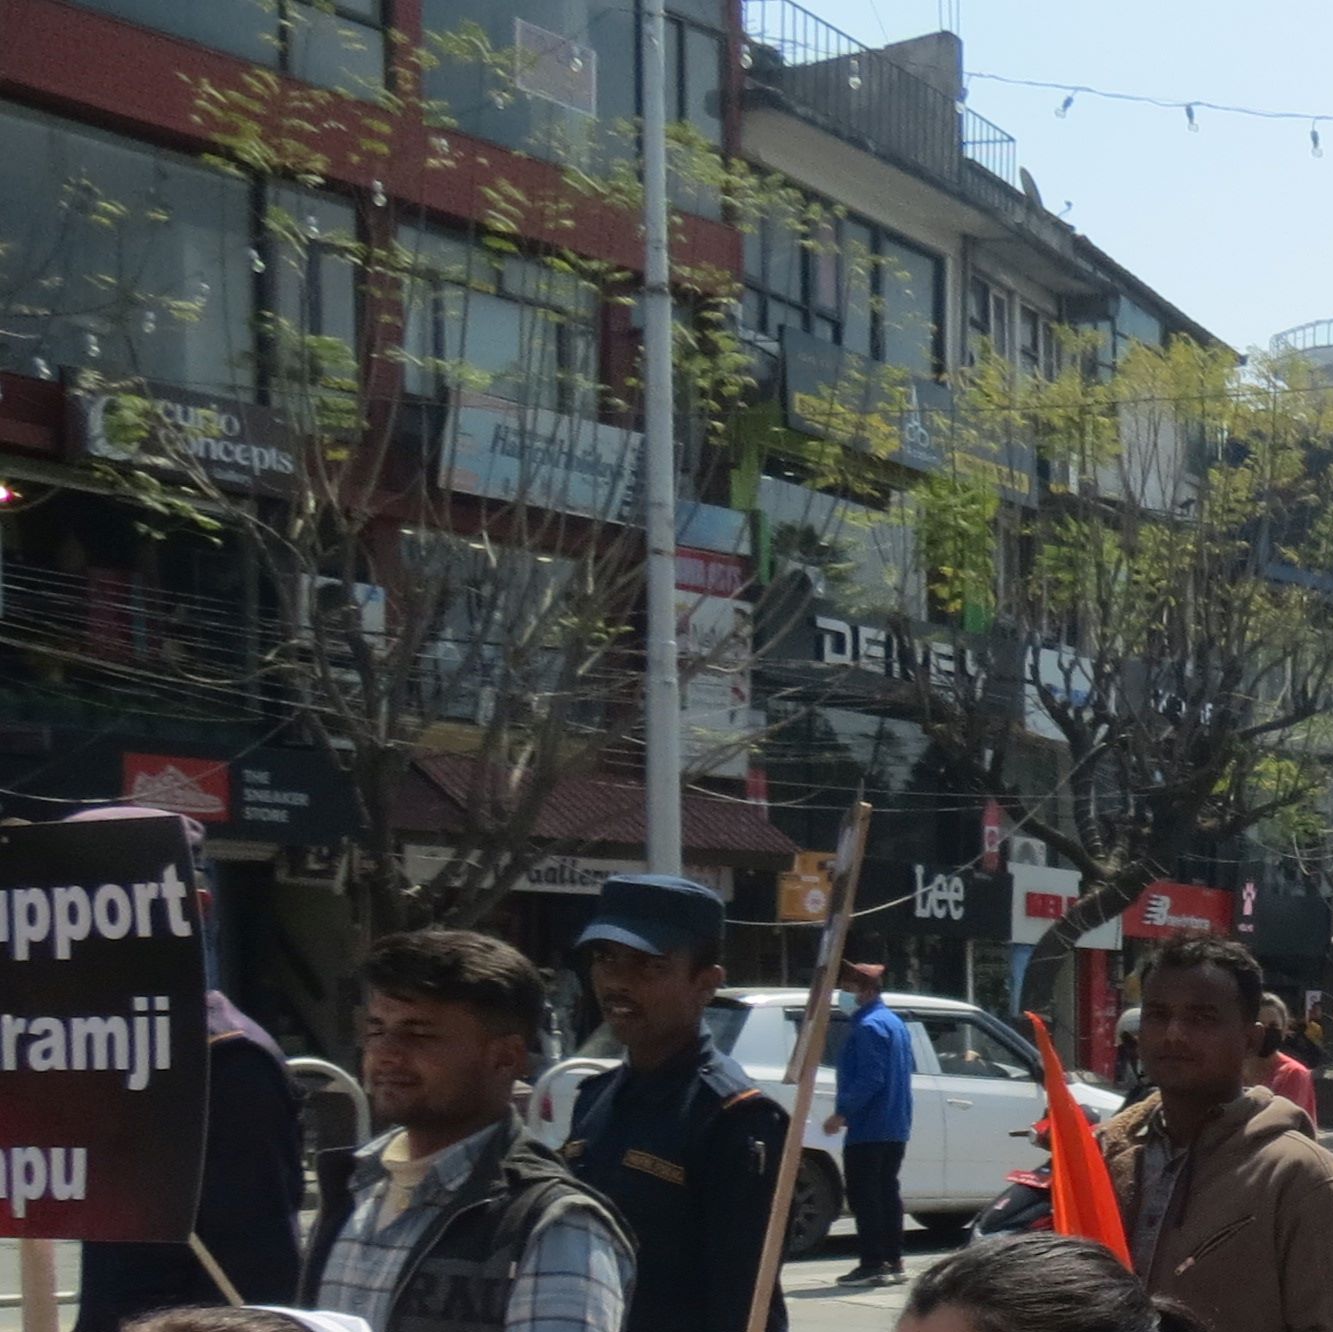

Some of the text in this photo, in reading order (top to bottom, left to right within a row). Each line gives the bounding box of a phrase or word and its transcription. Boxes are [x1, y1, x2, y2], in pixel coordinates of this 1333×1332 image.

[0, 863, 193, 961] pport
[915, 863, 965, 921] Lee
[0, 1146, 87, 1219] pu
